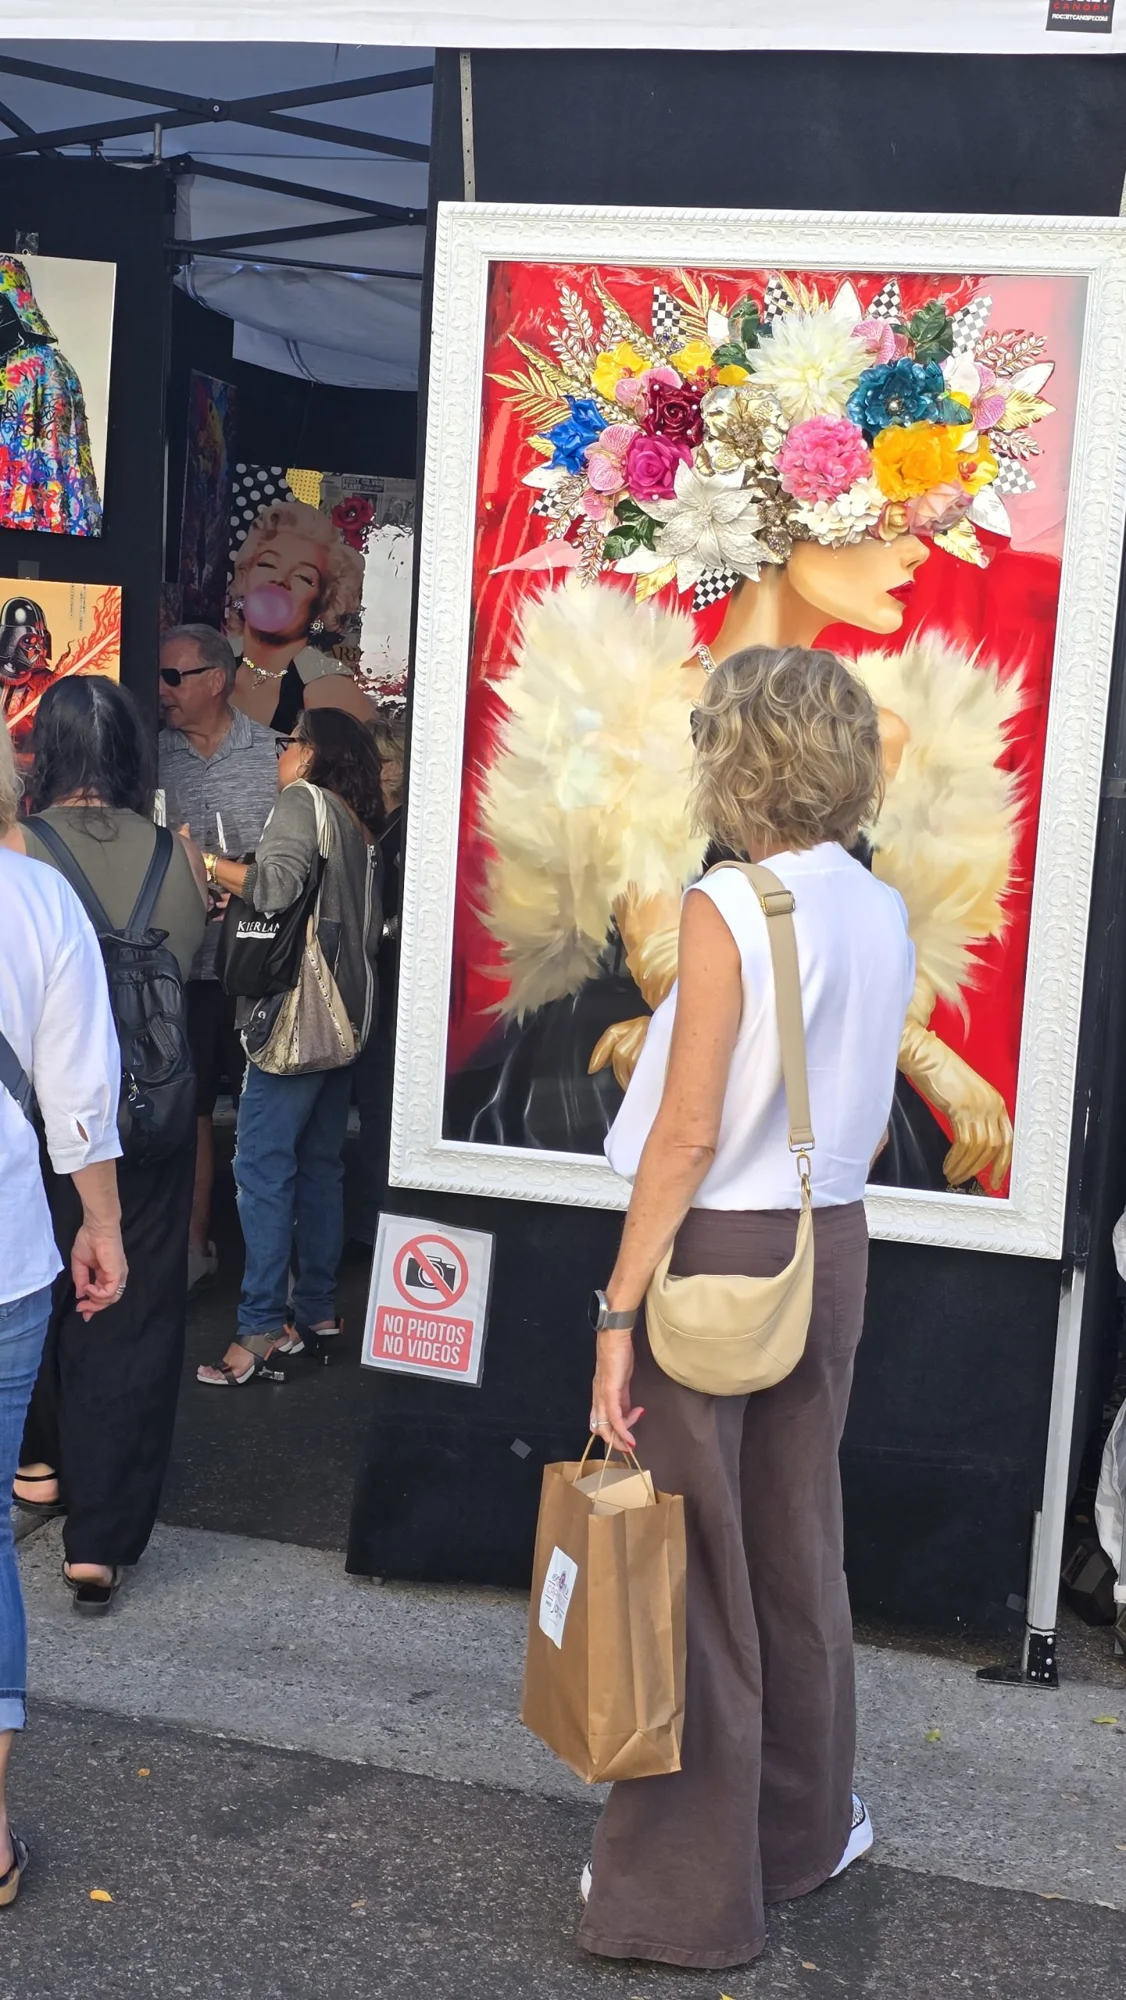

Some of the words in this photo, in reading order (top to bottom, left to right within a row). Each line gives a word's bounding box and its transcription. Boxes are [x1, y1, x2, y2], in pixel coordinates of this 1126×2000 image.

[1053, 2, 1109, 11] CANOPY
[382, 1313, 404, 1334] NO
[407, 1318, 466, 1345] PHOTOS
[382, 1334, 404, 1355] NO
[407, 1338, 460, 1365] VIDEOS
